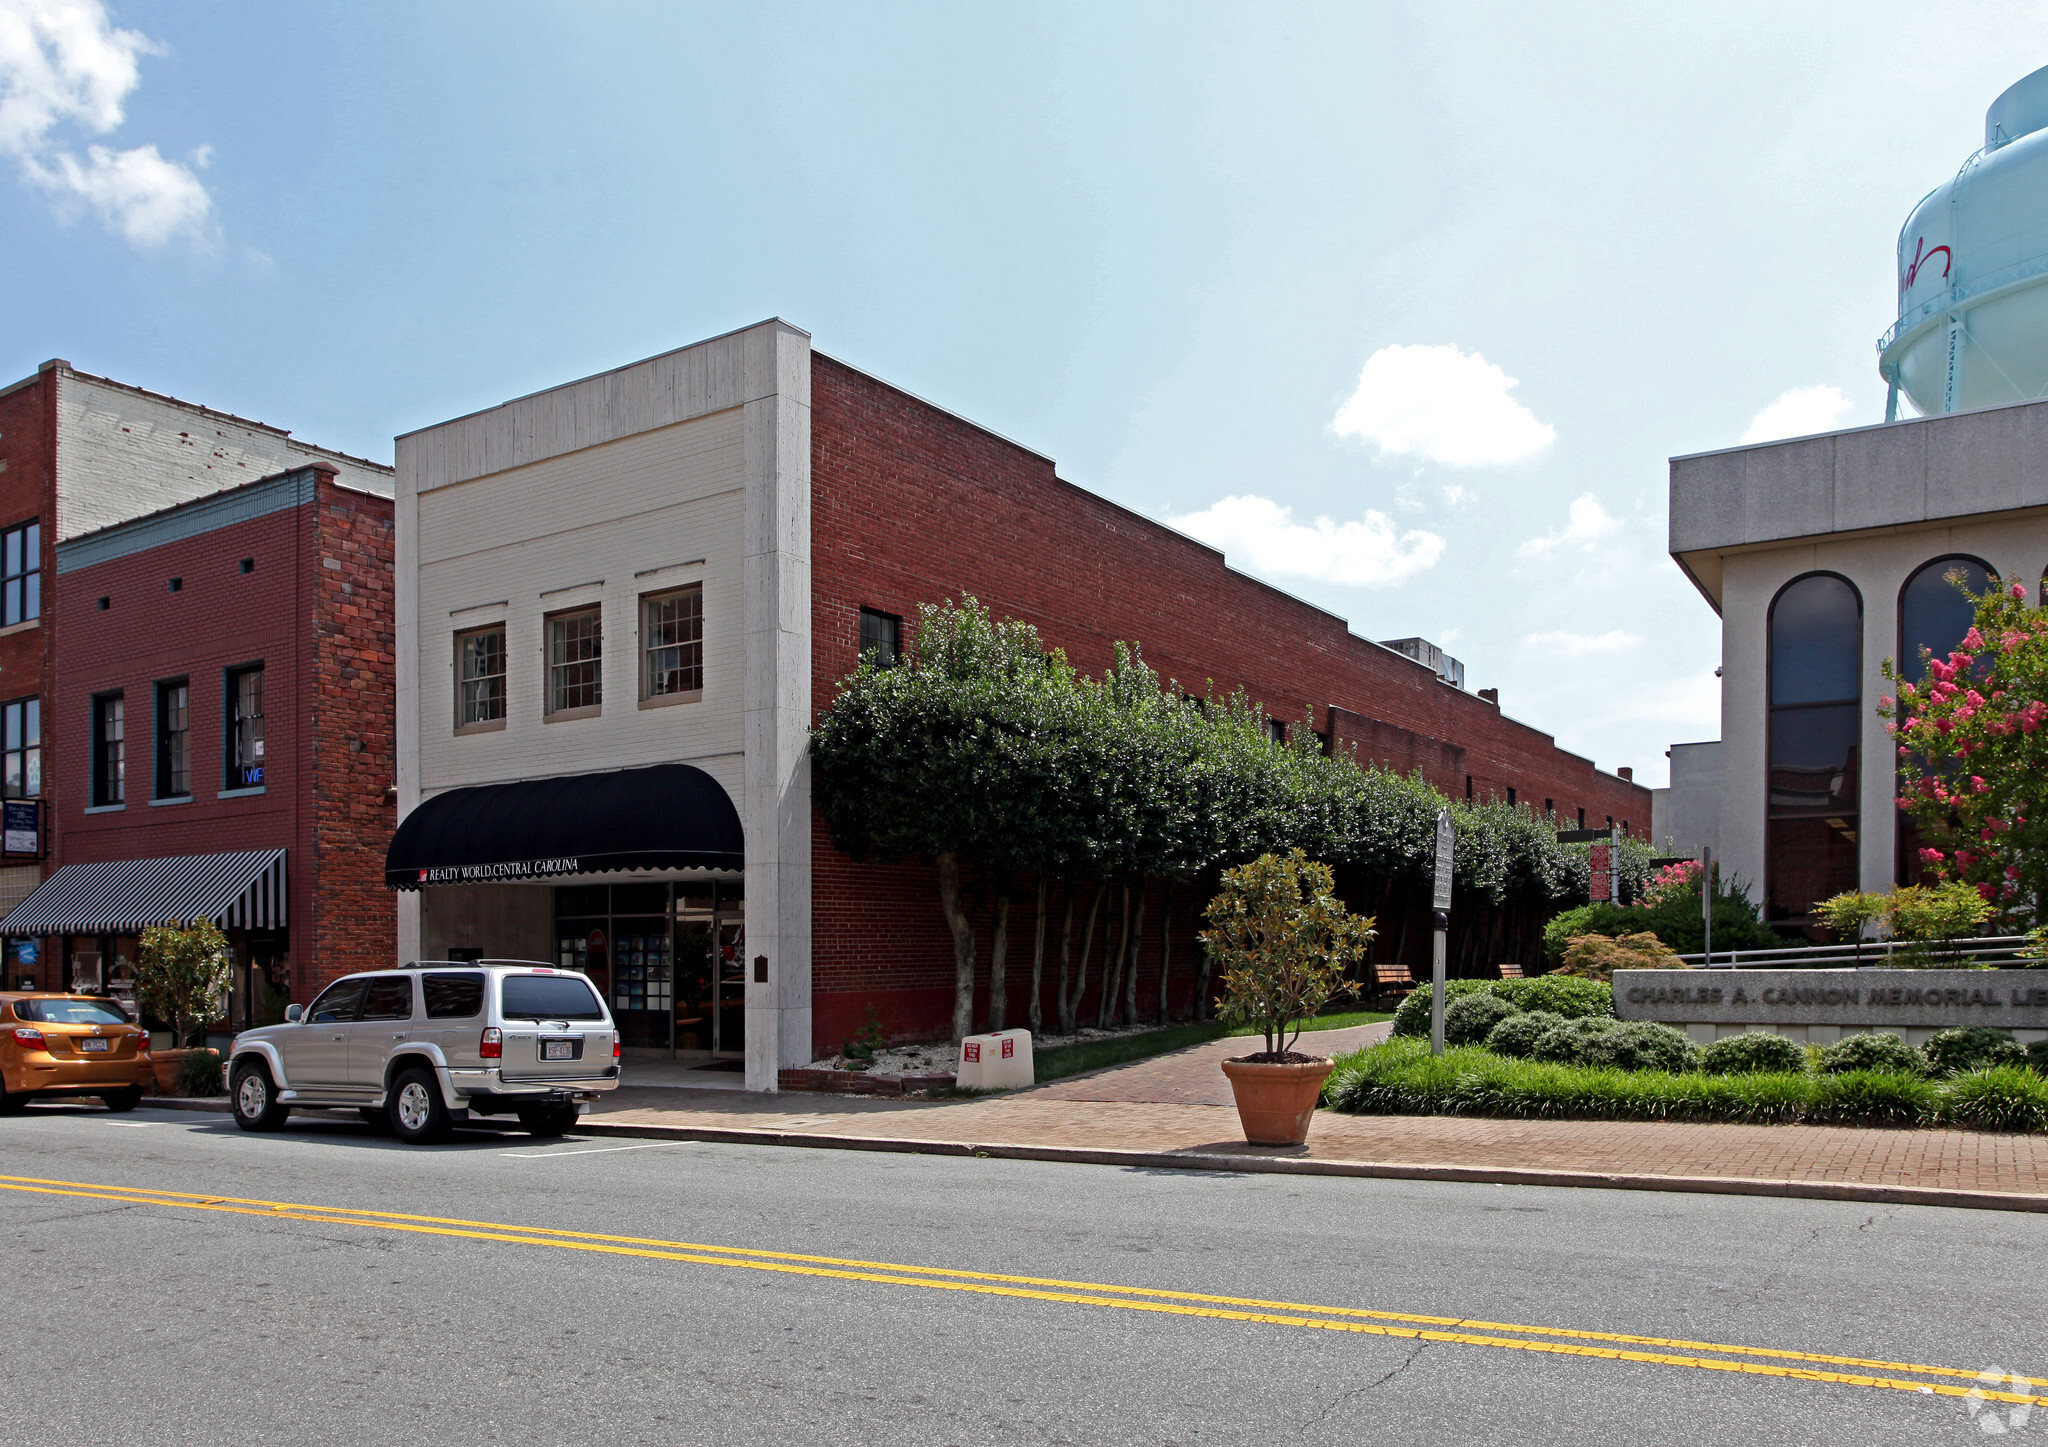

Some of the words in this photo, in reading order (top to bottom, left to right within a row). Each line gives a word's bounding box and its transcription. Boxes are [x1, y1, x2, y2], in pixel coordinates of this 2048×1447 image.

[429, 867, 459, 881] REALTY
[534, 858, 578, 873] CAROLINA
[1627, 986, 1724, 1004] CHARLES
[1762, 987, 1859, 1006] CANNON
[1867, 988, 2002, 1006] MEMORIAL
